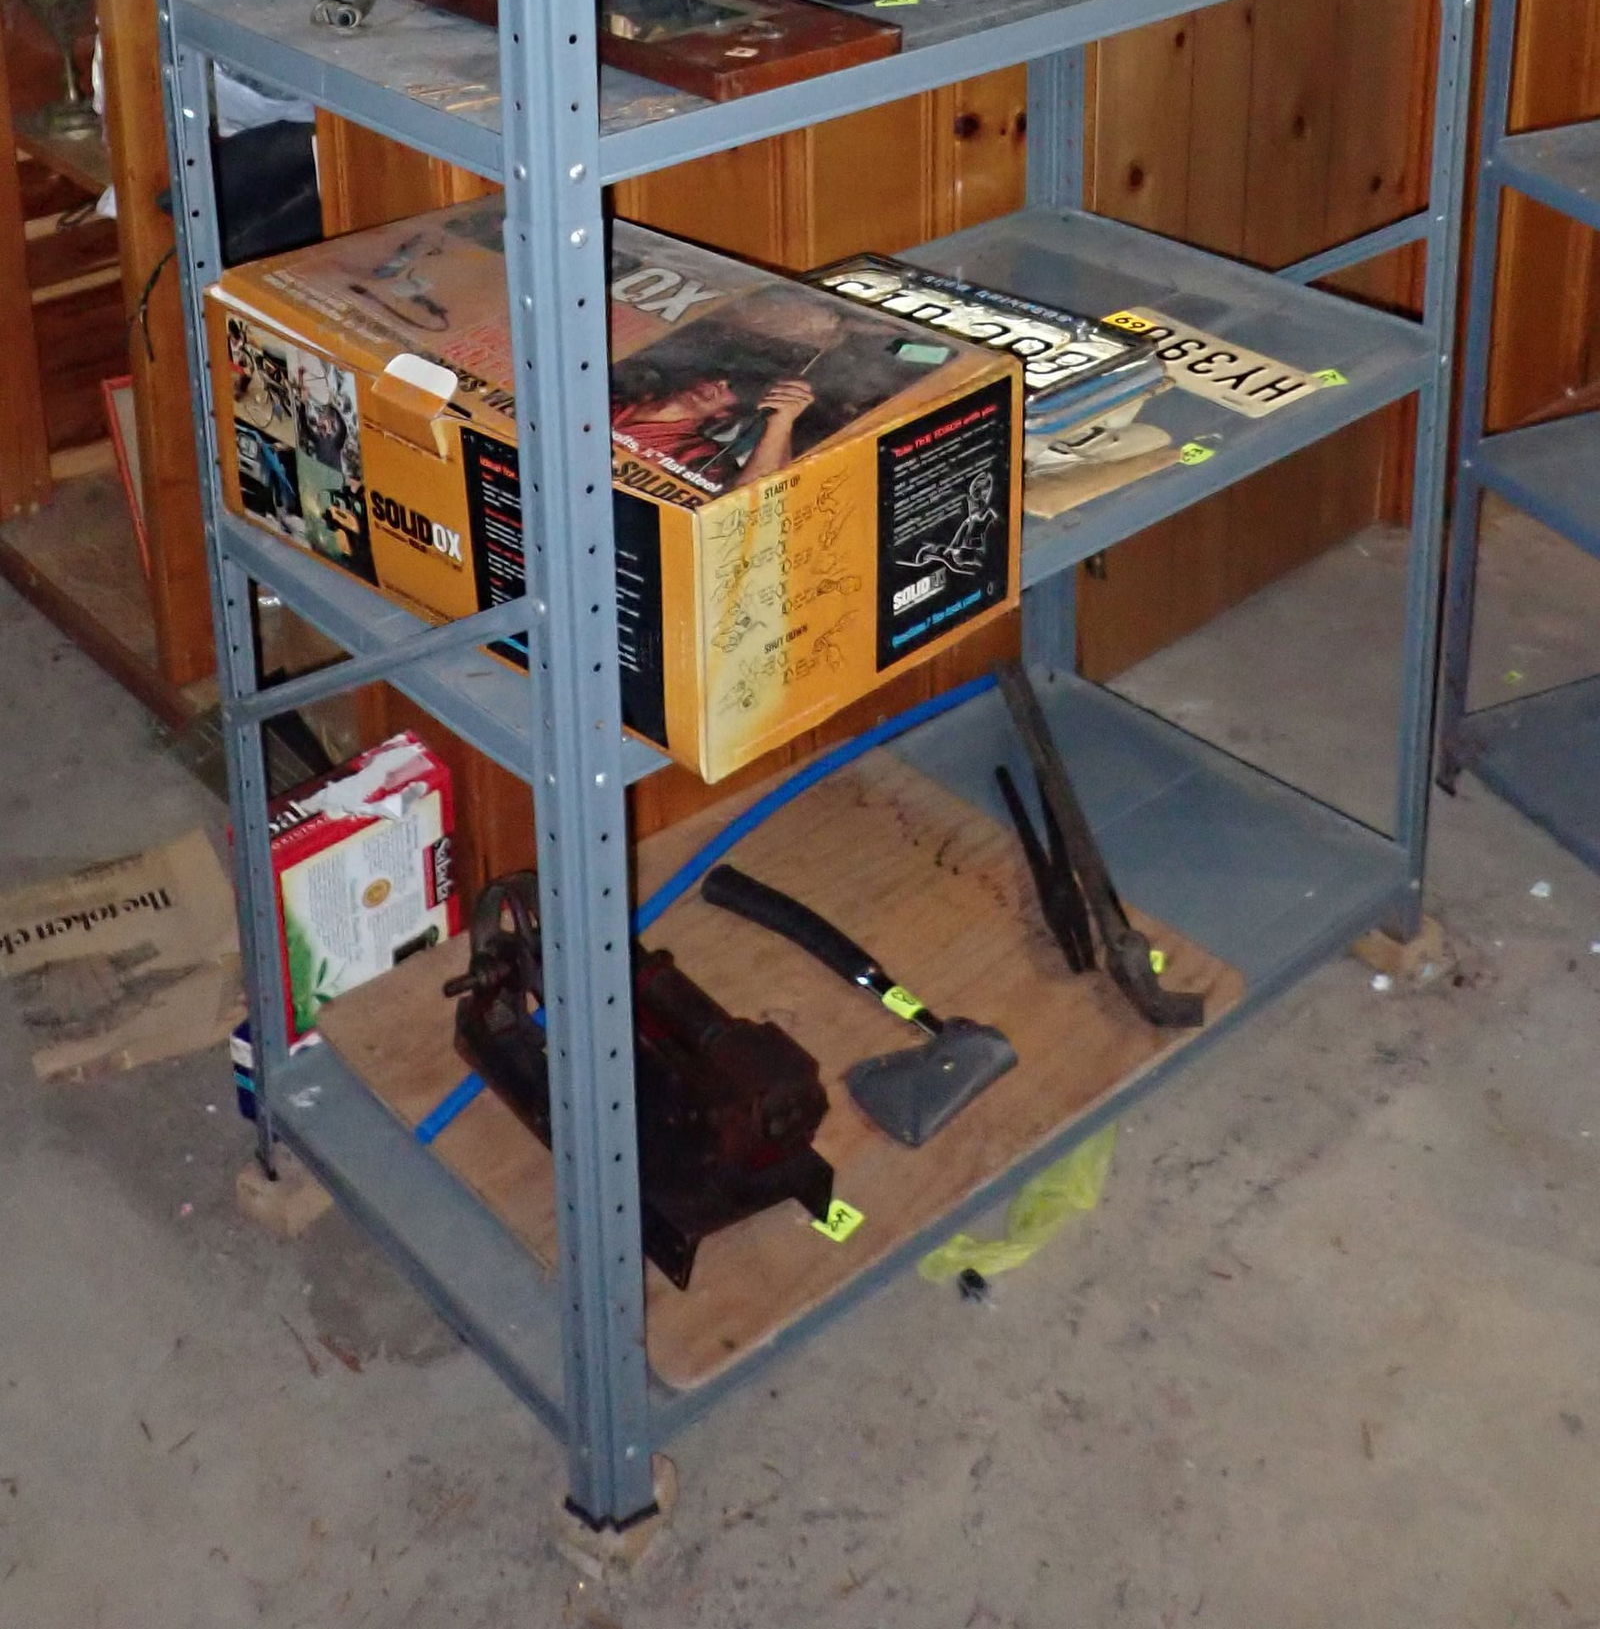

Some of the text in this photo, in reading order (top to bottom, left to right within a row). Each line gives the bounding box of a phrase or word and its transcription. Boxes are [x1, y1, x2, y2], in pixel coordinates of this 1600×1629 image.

[764, 482, 788, 500] START
[370, 489, 463, 563] SOLIDOX
[271, 814, 329, 851] ORIGINA
[123, 887, 173, 912] The
[35, 902, 118, 943] token
